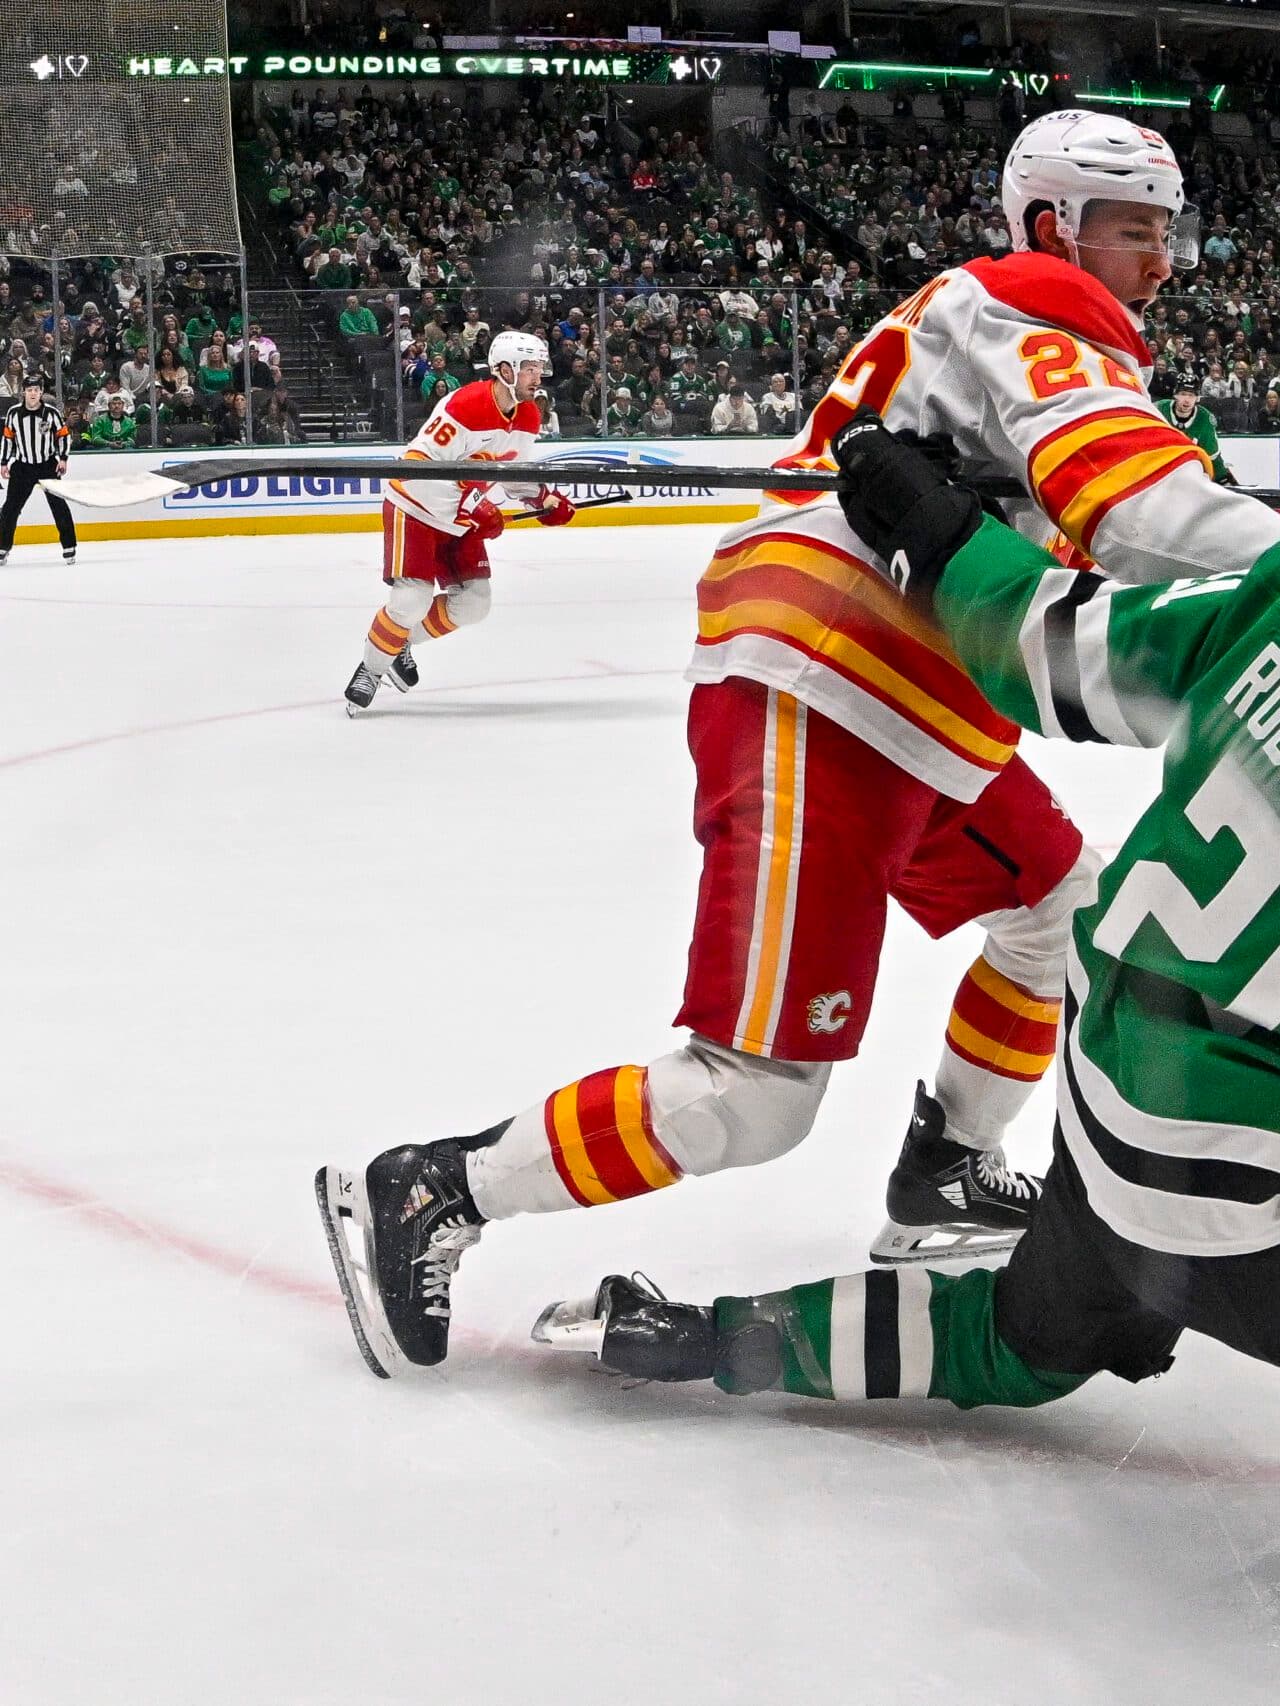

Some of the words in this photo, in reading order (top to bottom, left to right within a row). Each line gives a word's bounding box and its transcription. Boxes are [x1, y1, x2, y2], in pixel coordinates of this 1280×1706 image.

[129, 57, 249, 75] HEART
[264, 57, 440, 75] POUNDING
[455, 57, 630, 76] OVERTIME
[424, 416, 457, 446] 86
